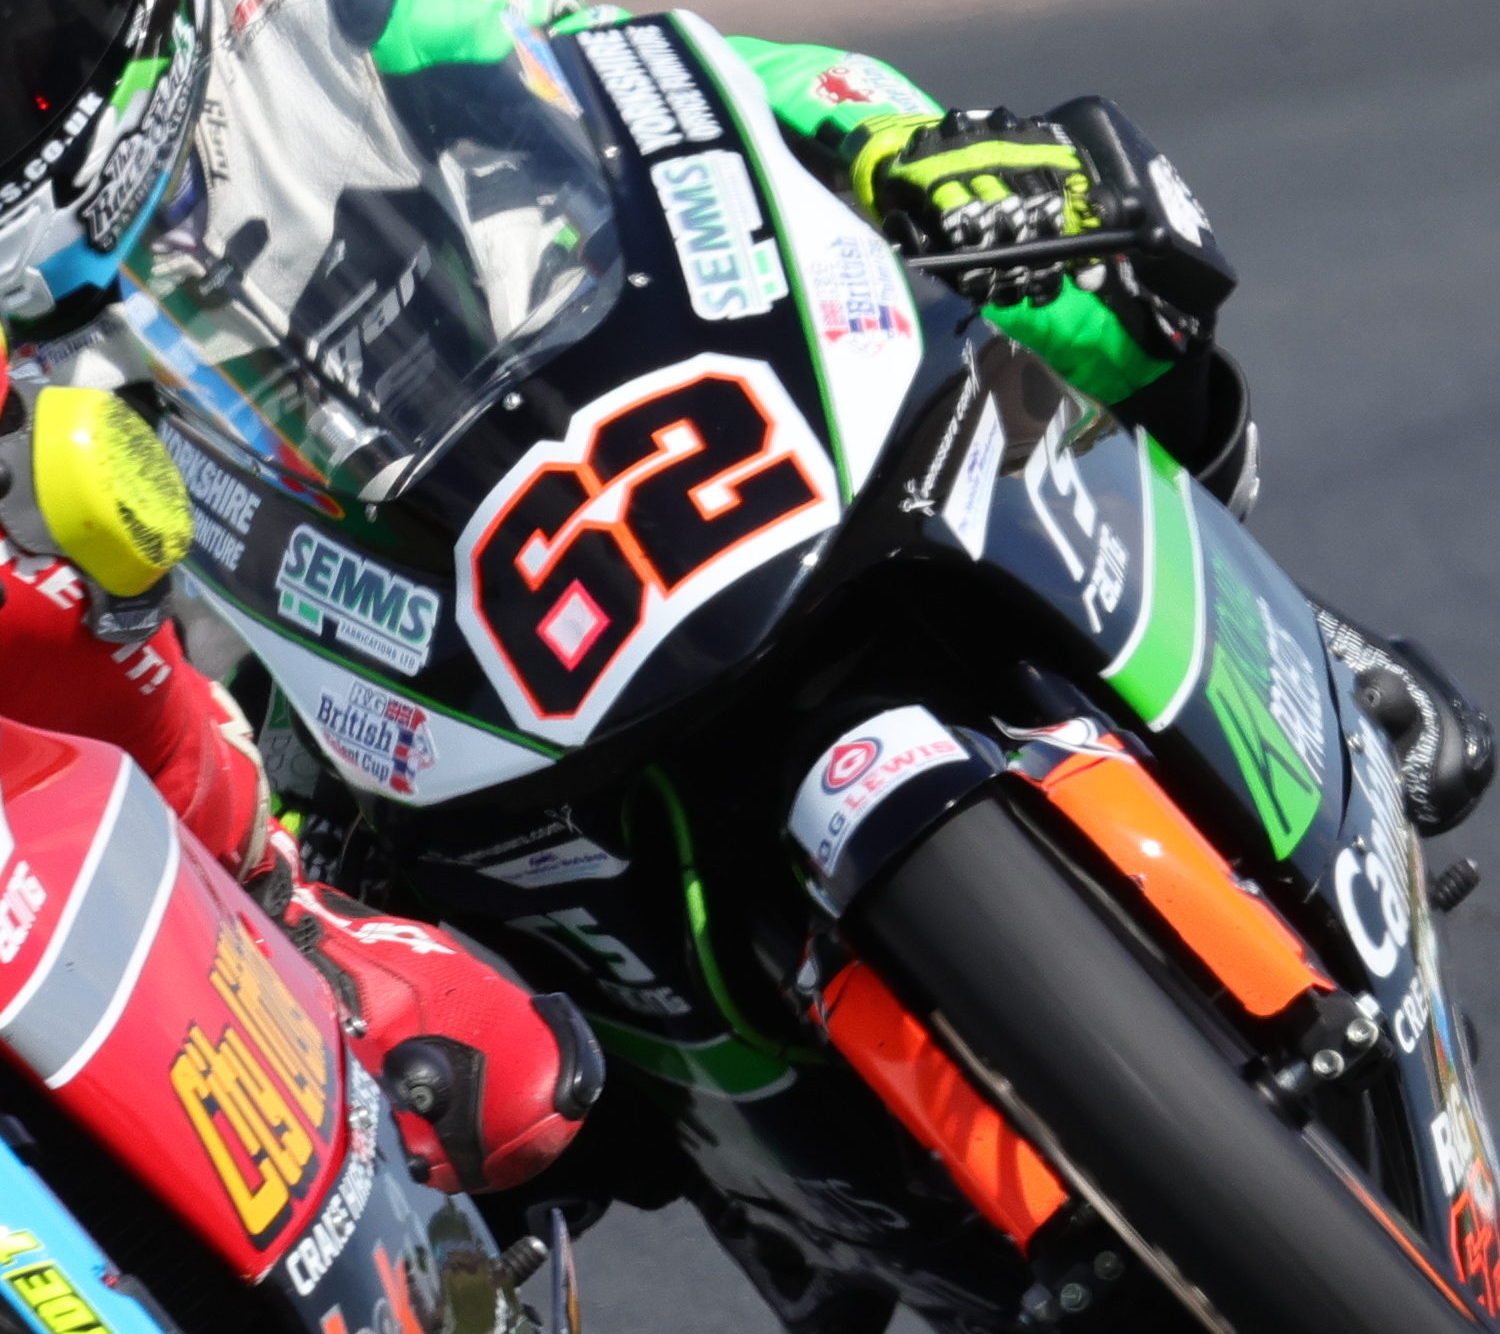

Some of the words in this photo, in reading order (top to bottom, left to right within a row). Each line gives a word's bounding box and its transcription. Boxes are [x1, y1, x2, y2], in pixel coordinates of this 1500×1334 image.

[577, 27, 686, 157] YORKSHIRE
[663, 162, 748, 313] SEMMS
[283, 530, 431, 644] SEMMS
[470, 371, 824, 720] 62
[340, 621, 399, 661] FABRICATIONS
[399, 651, 416, 670] LTD
[316, 692, 394, 753] British
[361, 753, 390, 783] Cup
